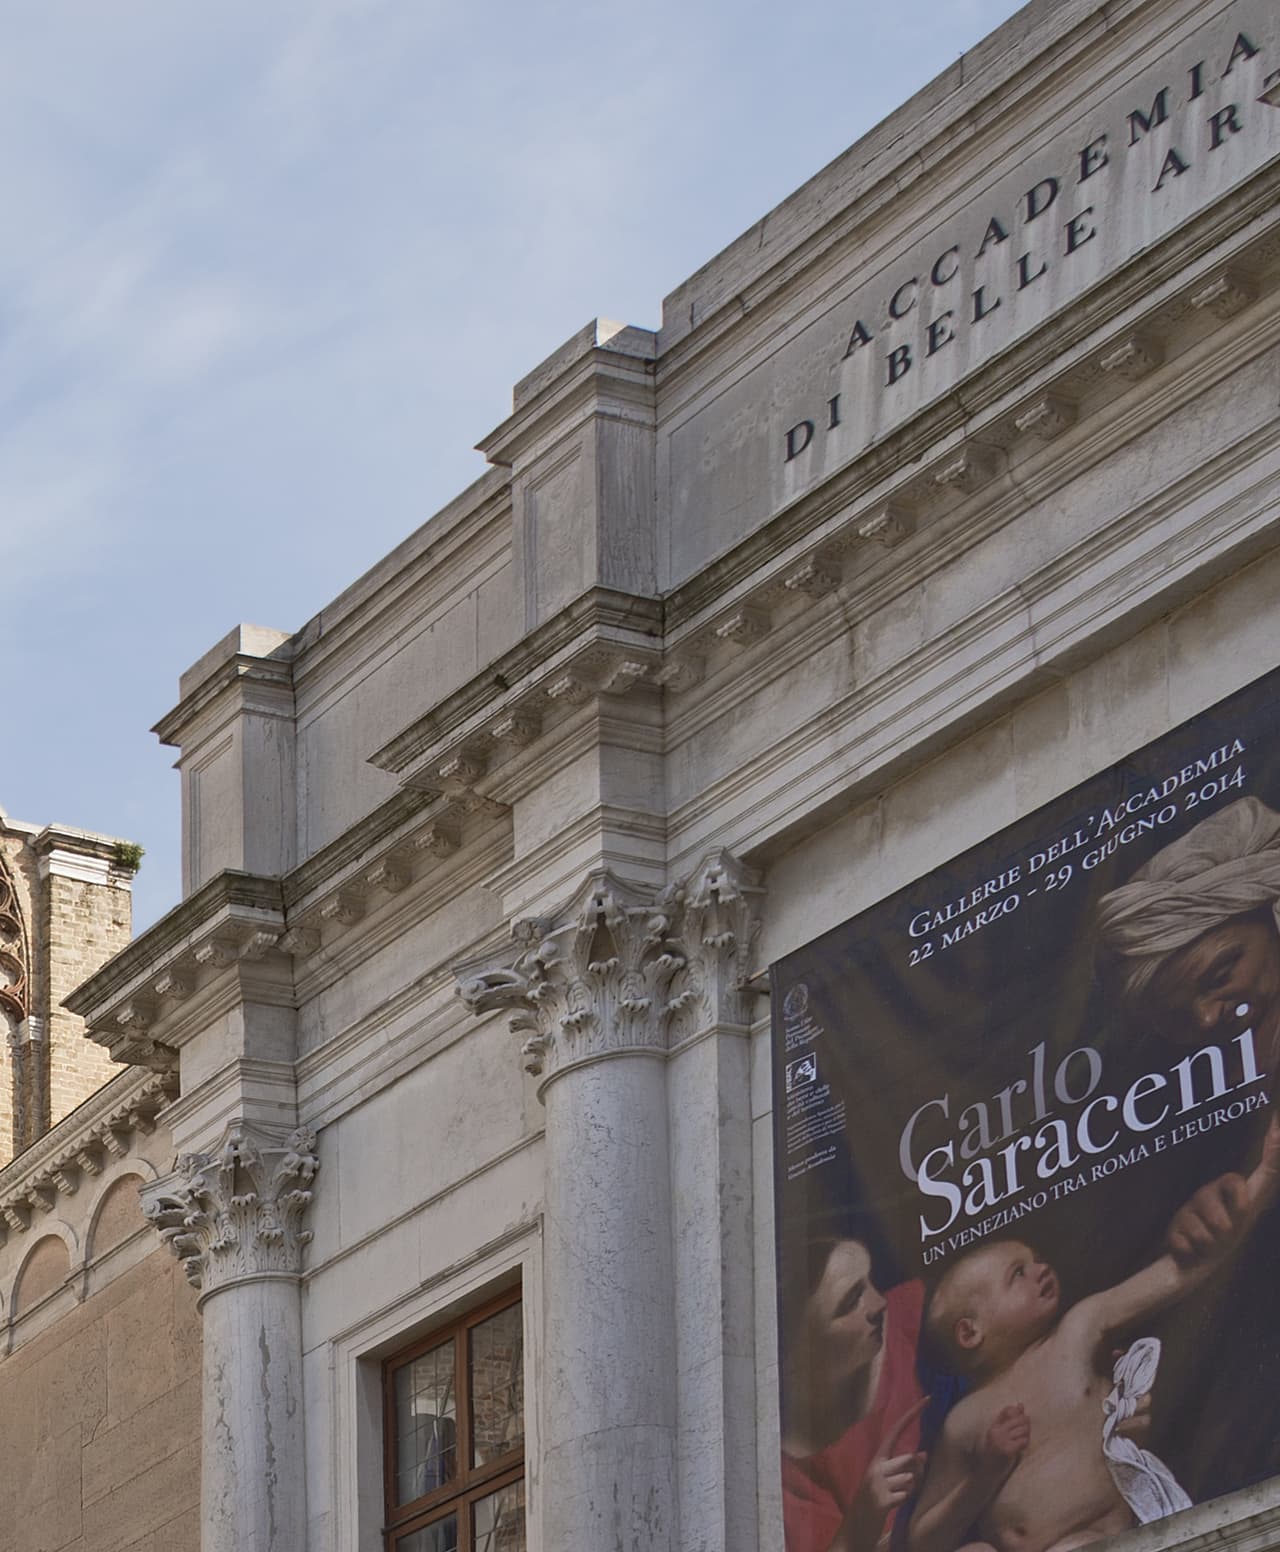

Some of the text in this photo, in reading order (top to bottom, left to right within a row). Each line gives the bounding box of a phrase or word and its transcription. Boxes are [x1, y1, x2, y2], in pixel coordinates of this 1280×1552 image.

[784, 68, 1280, 463] DI BELLE AR
[842, 32, 1261, 361] ACCADEMIA
[908, 942, 934, 968] 22
[940, 894, 1021, 951] MARZO
[1044, 864, 1074, 892] 29
[1081, 803, 1178, 871] GIUGNO
[1185, 766, 1247, 812] 2014
[908, 866, 1021, 939] GALLERIE
[899, 1040, 1103, 1183] Carlo
[917, 1003, 1266, 1243] Saraceni
[922, 1090, 1270, 1266] UN VENEZIANO TRA ROMA E L'EUROPA
